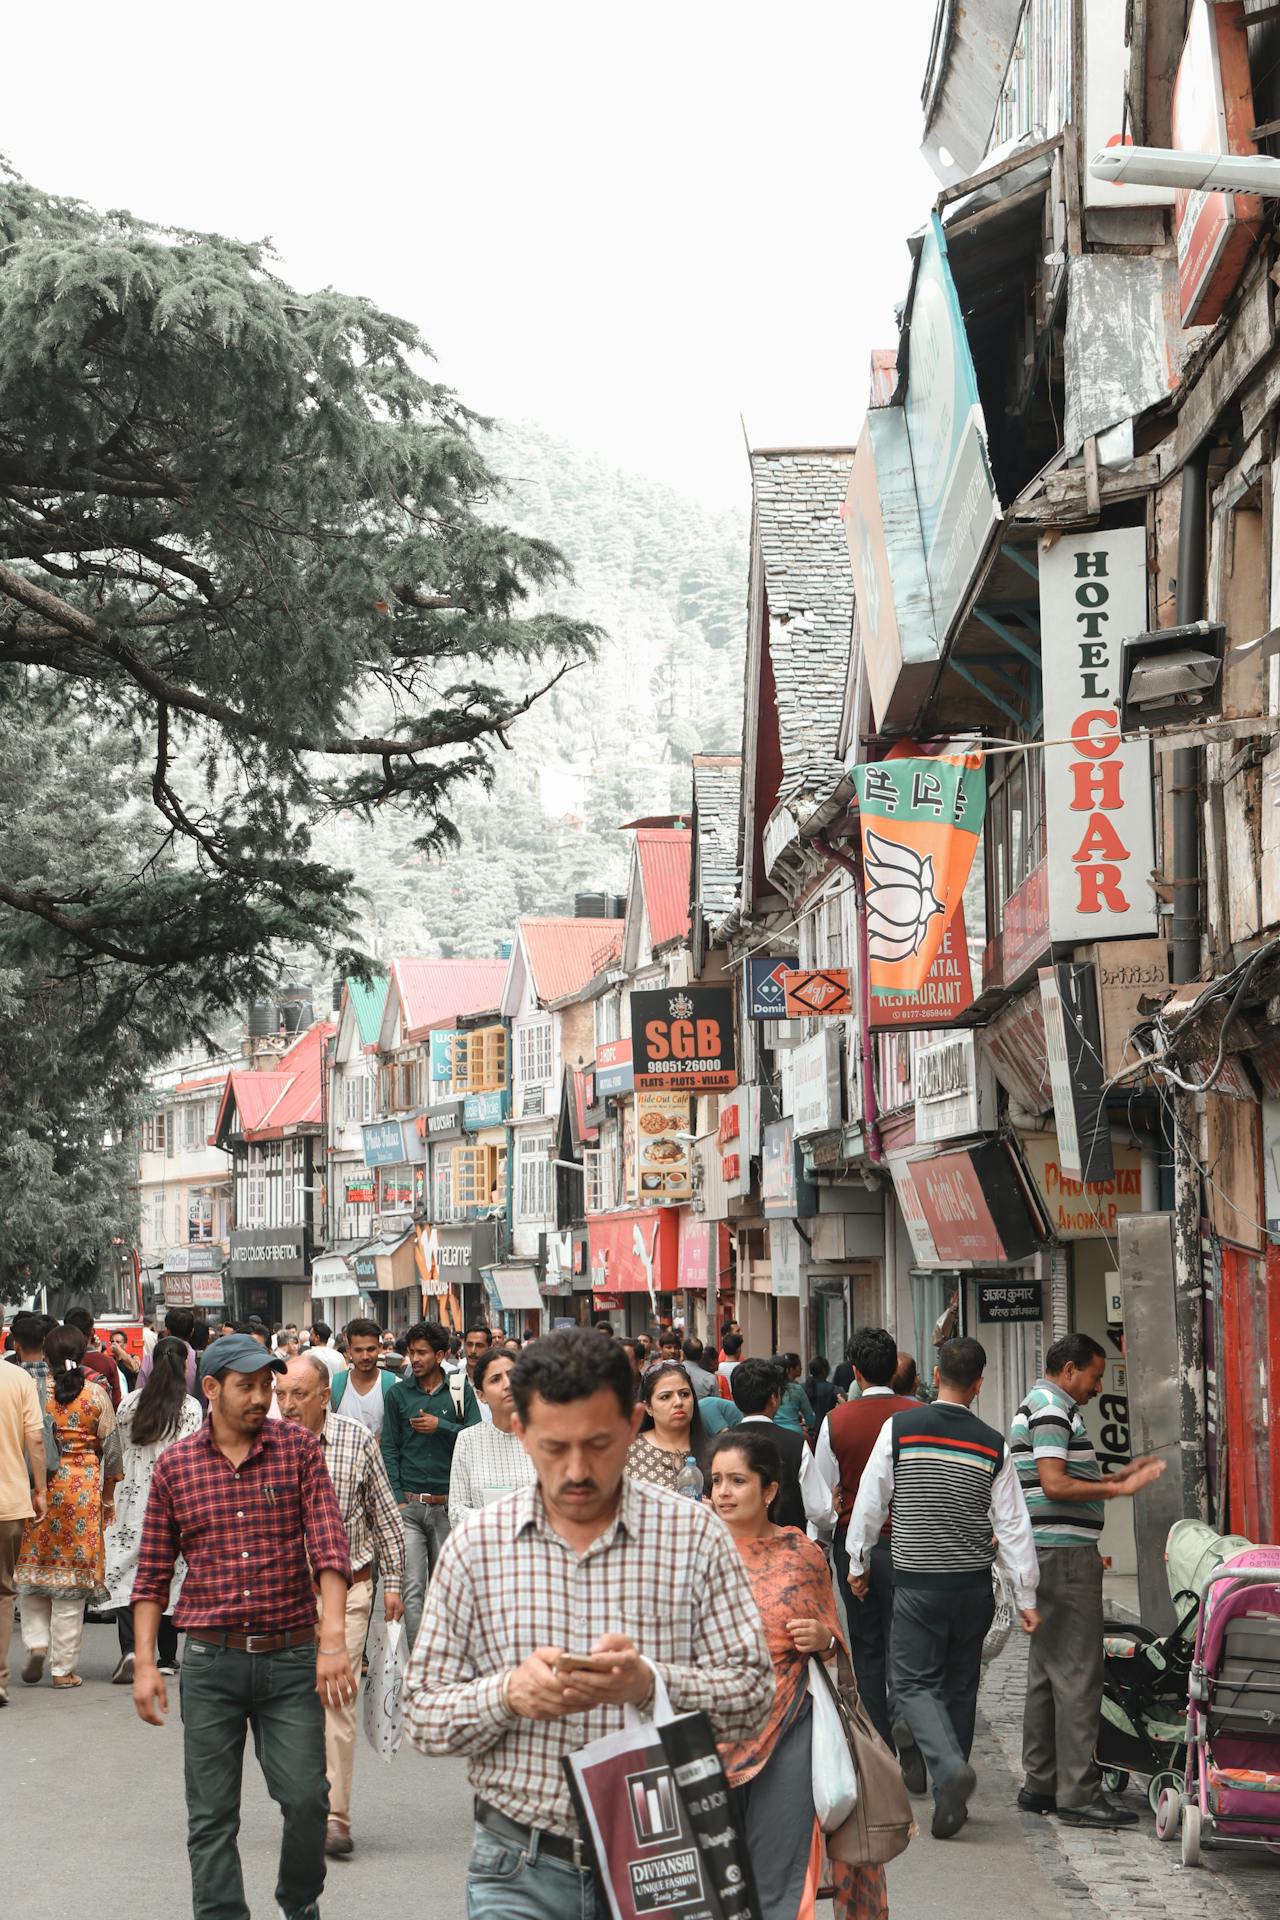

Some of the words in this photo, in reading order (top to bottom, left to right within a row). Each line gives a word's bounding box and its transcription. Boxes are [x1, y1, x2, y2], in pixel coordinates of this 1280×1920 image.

[1073, 550, 1110, 699] HOTEL
[1069, 709, 1131, 914] GHAR
[927, 958, 962, 977] NTAL
[799, 982, 837, 1005] Agfa
[753, 1002, 786, 1014] Domin
[645, 1018, 722, 1061] SGB
[647, 1058, 722, 1074] 98051-26000
[640, 1077, 664, 1088] FLATS
[670, 1076, 696, 1086] PLOTS
[702, 1074, 730, 1085] VILLAS
[248, 1246, 265, 1261] COLORS
[437, 1246, 471, 1266] madame
[983, 1288, 1007, 1301] अजय
[1007, 1287, 1034, 1303] कुमार
[1112, 1295, 1122, 1310] B
[1096, 1393, 1132, 1475] dea
[632, 1853, 695, 1883] DIVYANSHI
[635, 1880, 665, 1896] UNIQUE
[664, 1872, 697, 1889] FASHION
